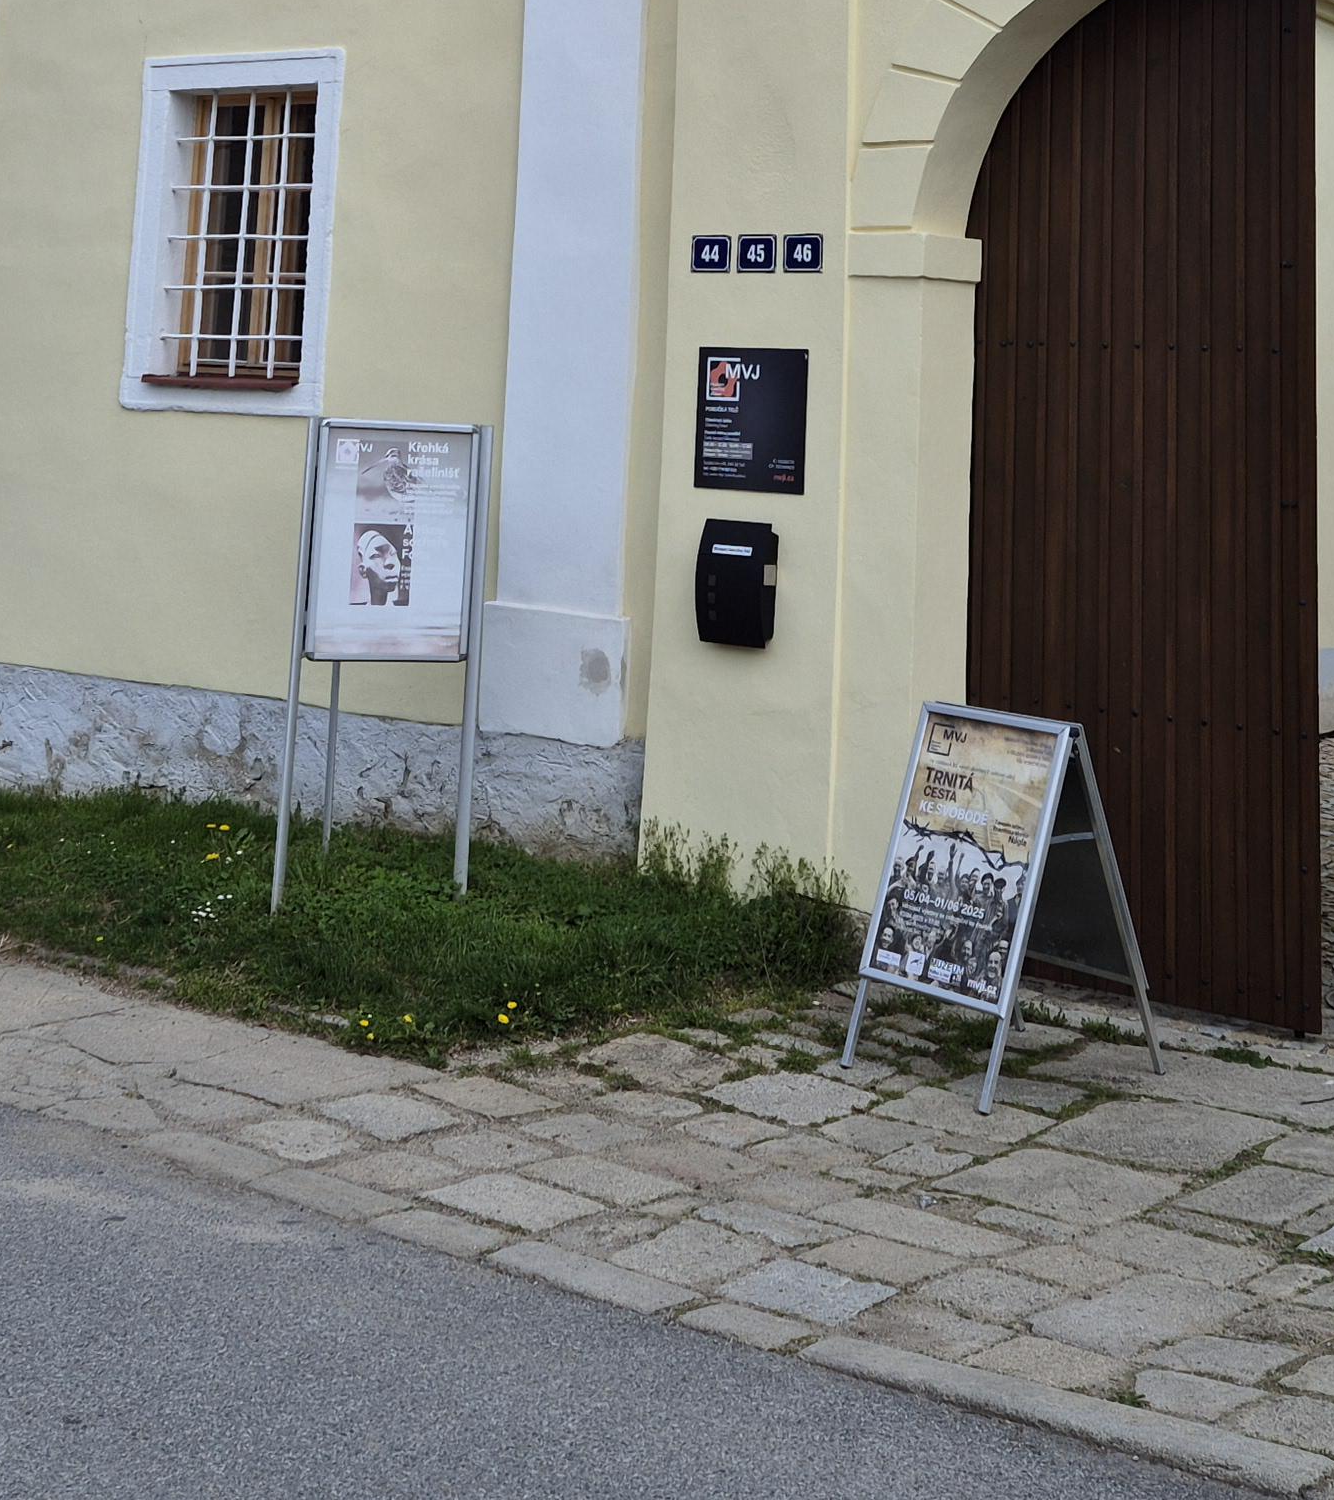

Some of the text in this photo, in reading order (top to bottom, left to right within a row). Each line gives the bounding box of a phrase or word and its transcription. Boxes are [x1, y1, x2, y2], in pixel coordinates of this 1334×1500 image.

[701, 244, 720, 263] 44
[747, 243, 765, 263] 45
[793, 243, 812, 262] 46
[725, 363, 761, 380] MVJ
[408, 454, 439, 465] krása
[943, 729, 968, 743] MVJ
[926, 766, 974, 793] TRNITÁ
[923, 785, 957, 803] CESTA
[919, 800, 934, 813] KE
